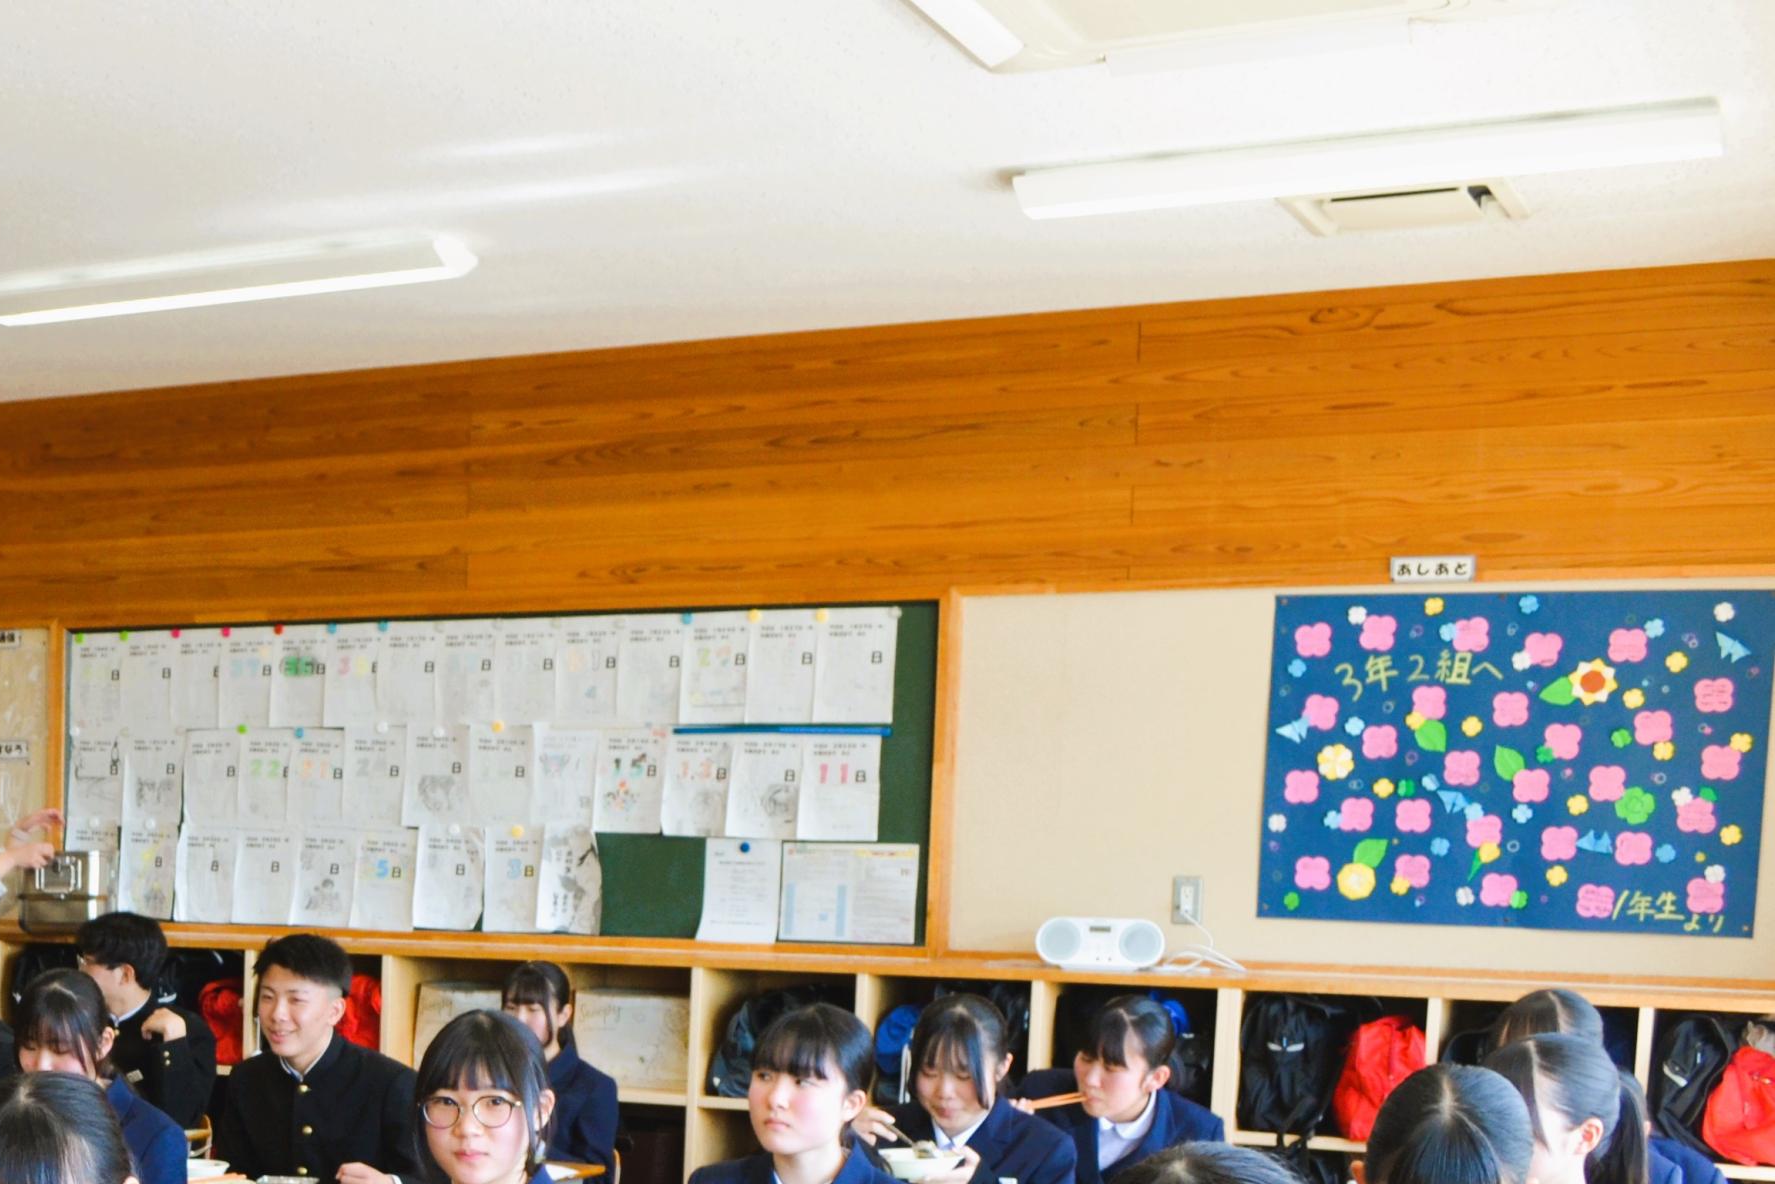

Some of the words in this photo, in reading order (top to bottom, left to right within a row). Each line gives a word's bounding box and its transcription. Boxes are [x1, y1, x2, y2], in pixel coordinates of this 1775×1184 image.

[1397, 562, 1467, 576] あしあと
[1334, 649, 1504, 702] 3年2組へ
